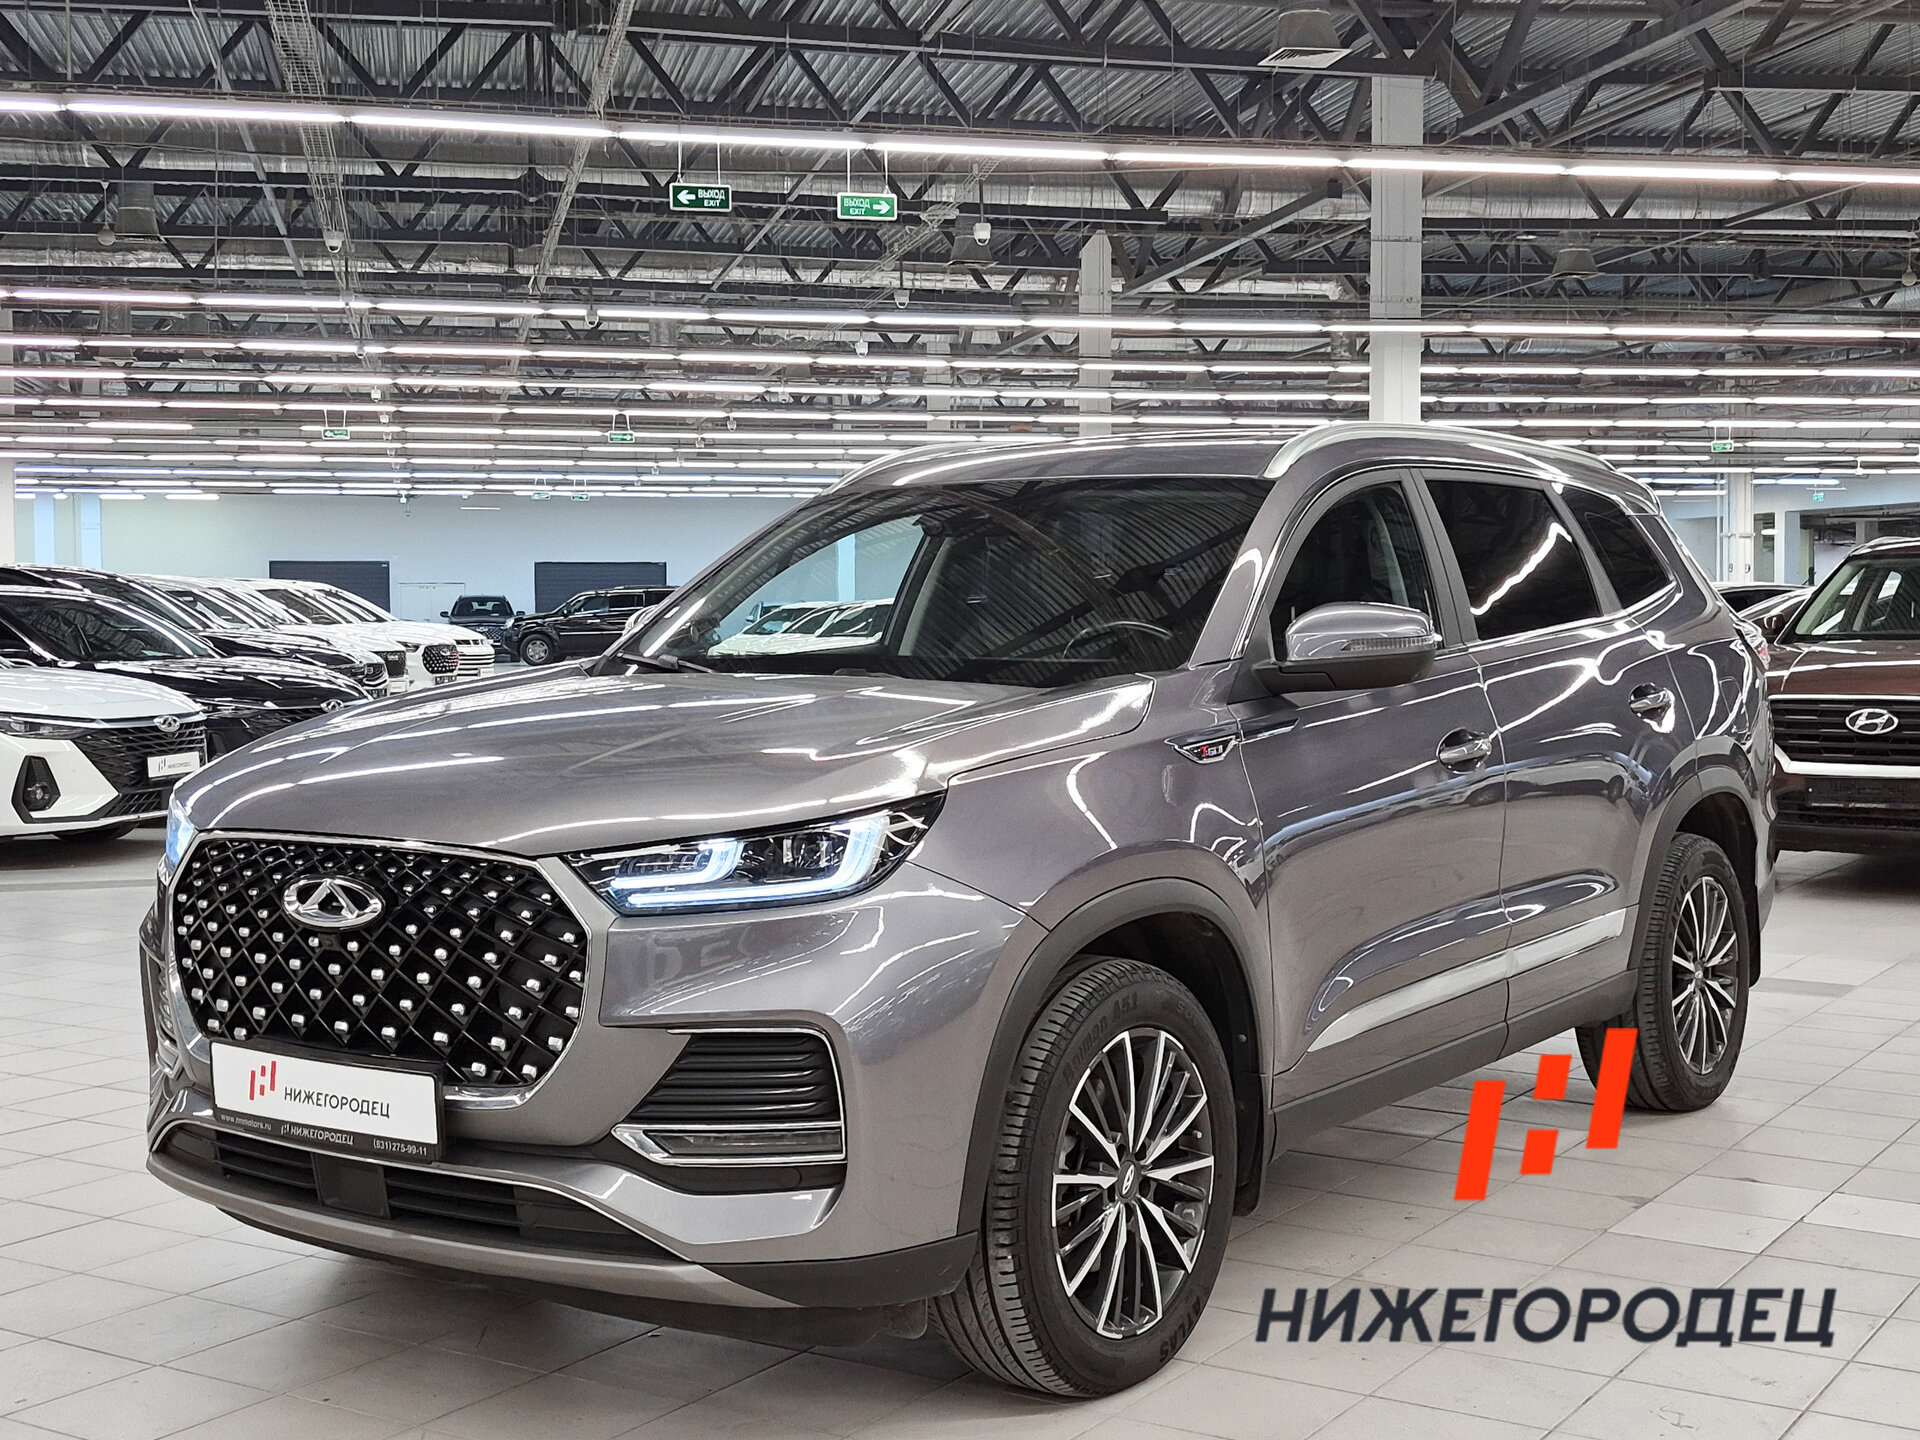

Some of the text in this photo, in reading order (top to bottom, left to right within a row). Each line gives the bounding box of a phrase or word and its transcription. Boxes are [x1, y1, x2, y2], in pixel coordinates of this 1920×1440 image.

[697, 189, 725, 200] ВЫХОД
[703, 199, 720, 207] EXIT
[843, 198, 870, 208] ВЫХОД
[849, 207, 865, 215] EXIT
[284, 1086, 390, 1118] НИЖЕГОРОДЕЦ
[290, 1125, 354, 1146] НИЖЕГОРОДЕЦ
[373, 1138, 427, 1156] (831)275-99-11
